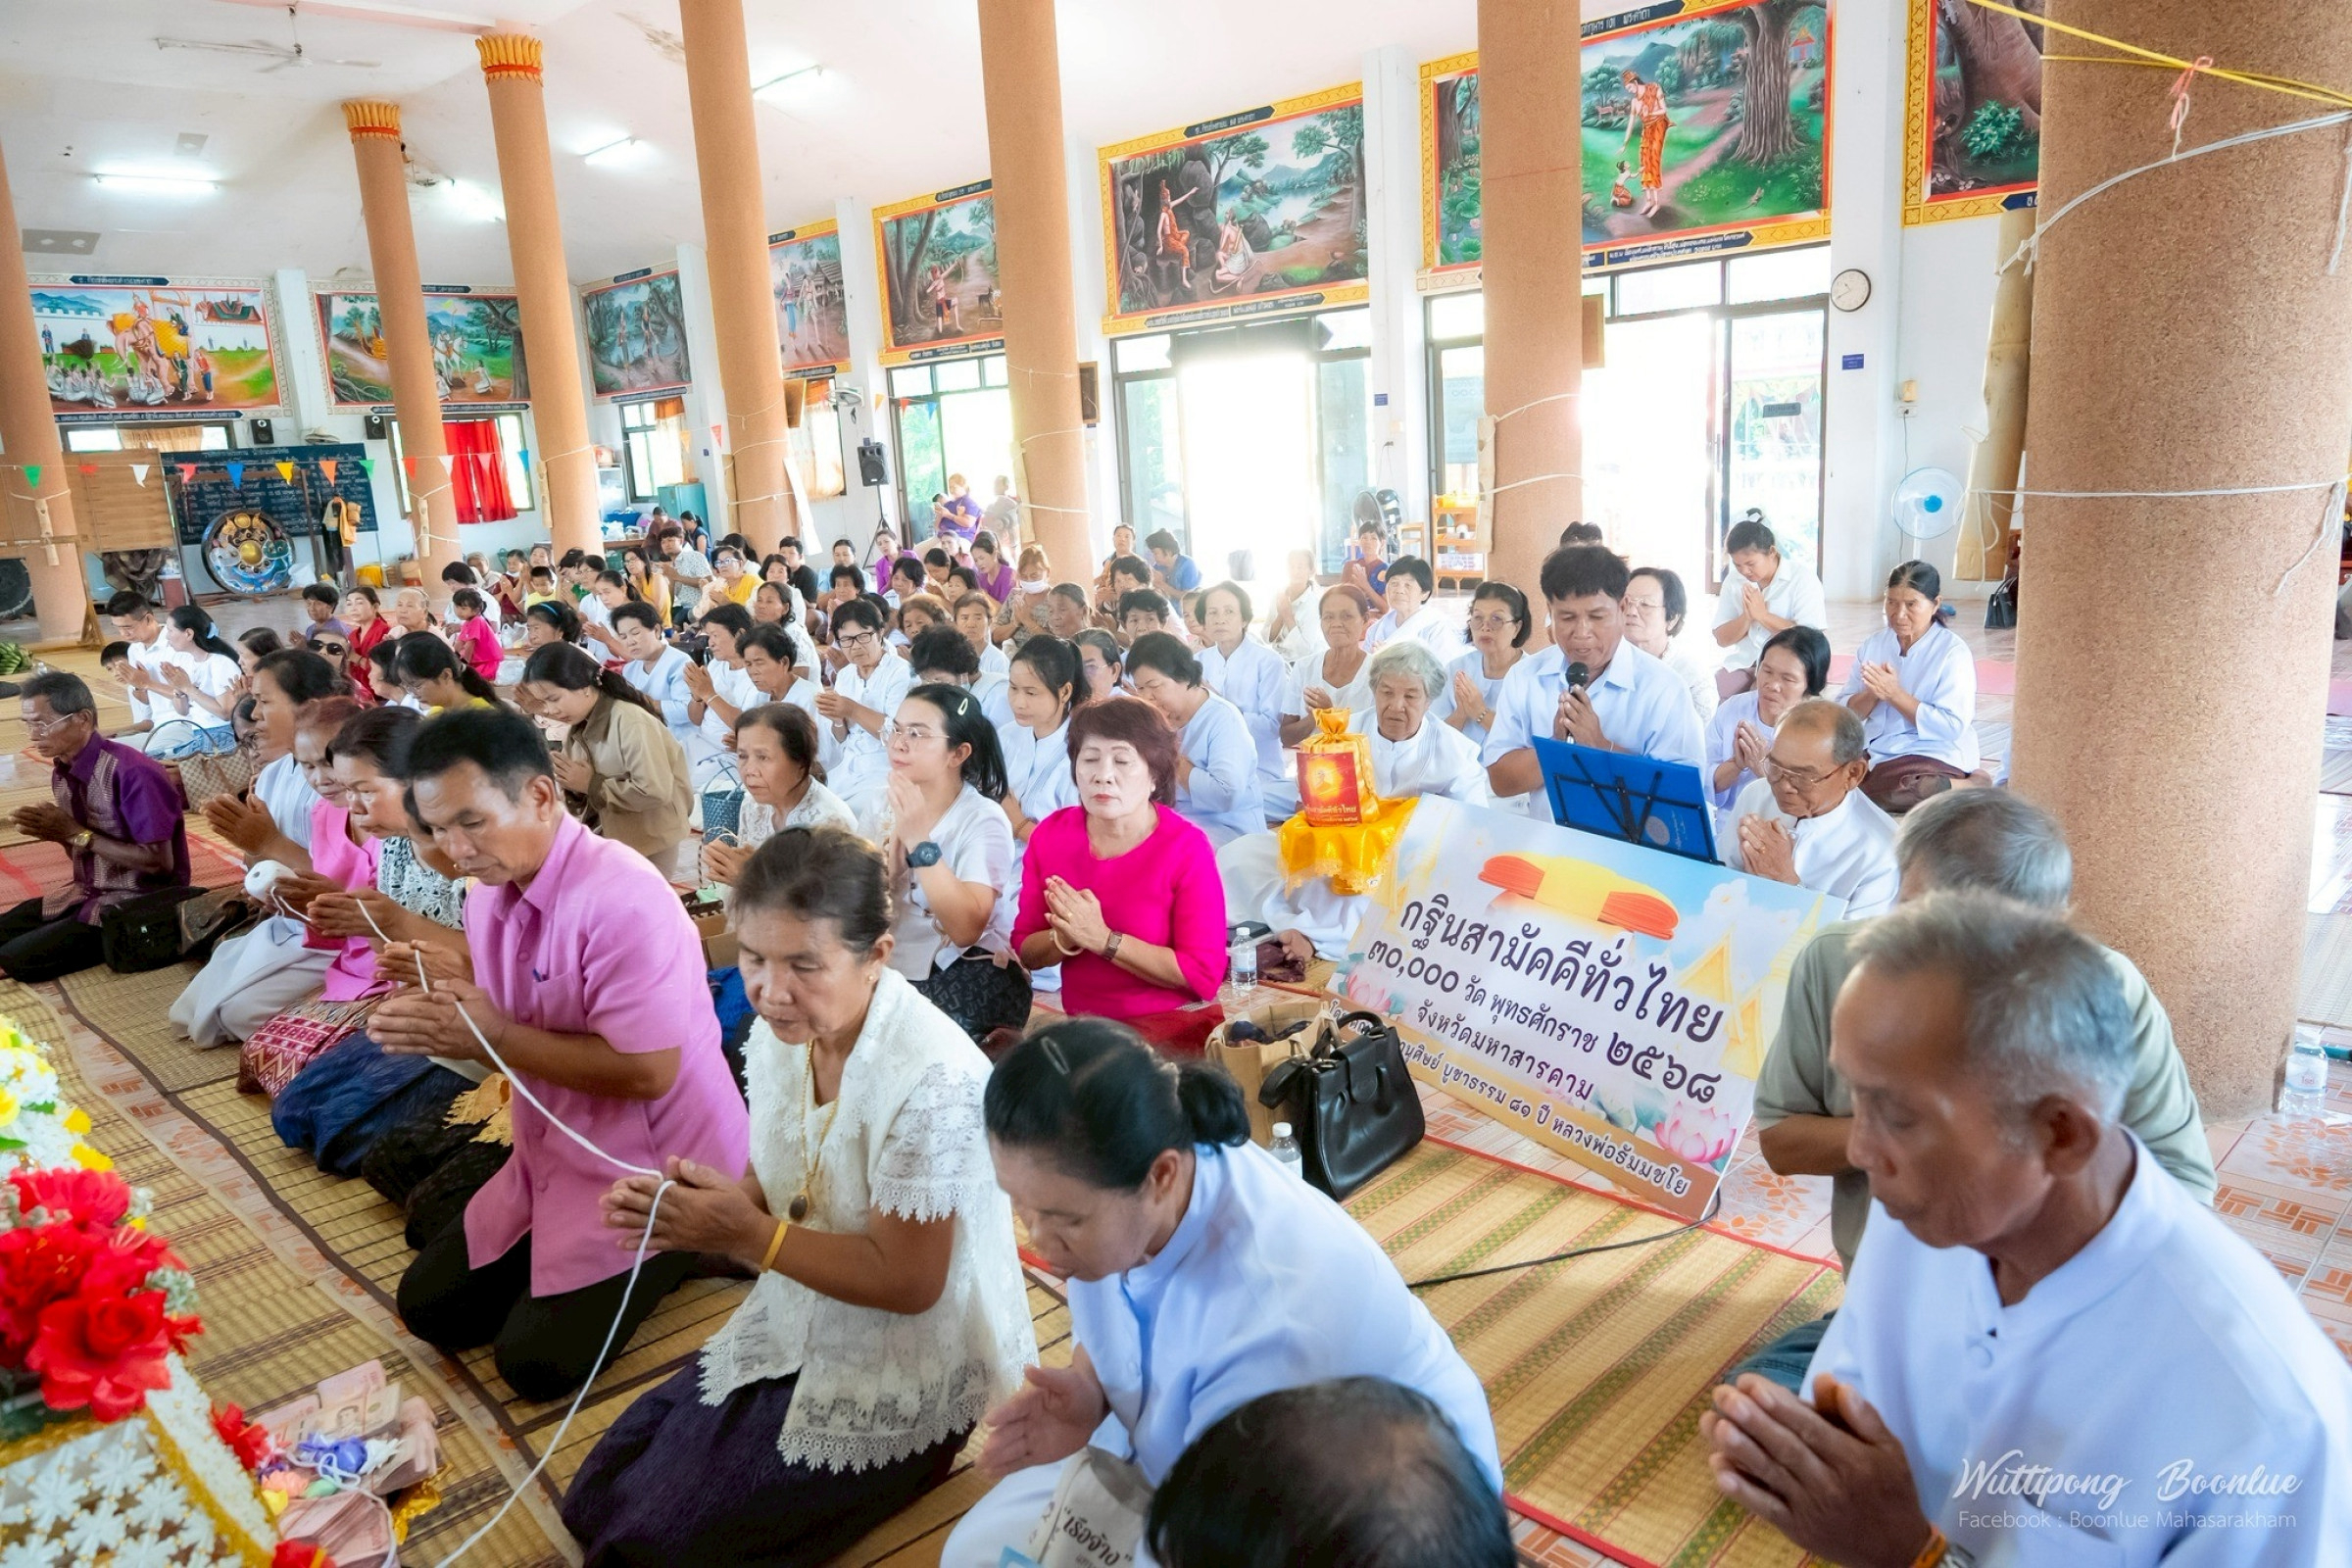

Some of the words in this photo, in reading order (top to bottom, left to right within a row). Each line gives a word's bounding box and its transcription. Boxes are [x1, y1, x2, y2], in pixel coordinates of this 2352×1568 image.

[1368, 940, 1459, 994] ๓๐,๐๐๐
[1464, 975, 1487, 1007] วัด
[1490, 994, 1599, 1054] พุทธศักราช
[1607, 1032, 1722, 1103] ๒๕๖๘
[1400, 893, 1724, 1043] กฐินสามัคคีทั่วไทย
[1417, 999, 1594, 1101] จังหวัดมหาสารคาม
[1442, 1062, 1507, 1104] บูชาธรรม
[1509, 1099, 1531, 1117] ๘๑
[1537, 1104, 1551, 1125] ปี
[1552, 1117, 1689, 1195] หลวงพ่อธัมมชโย
